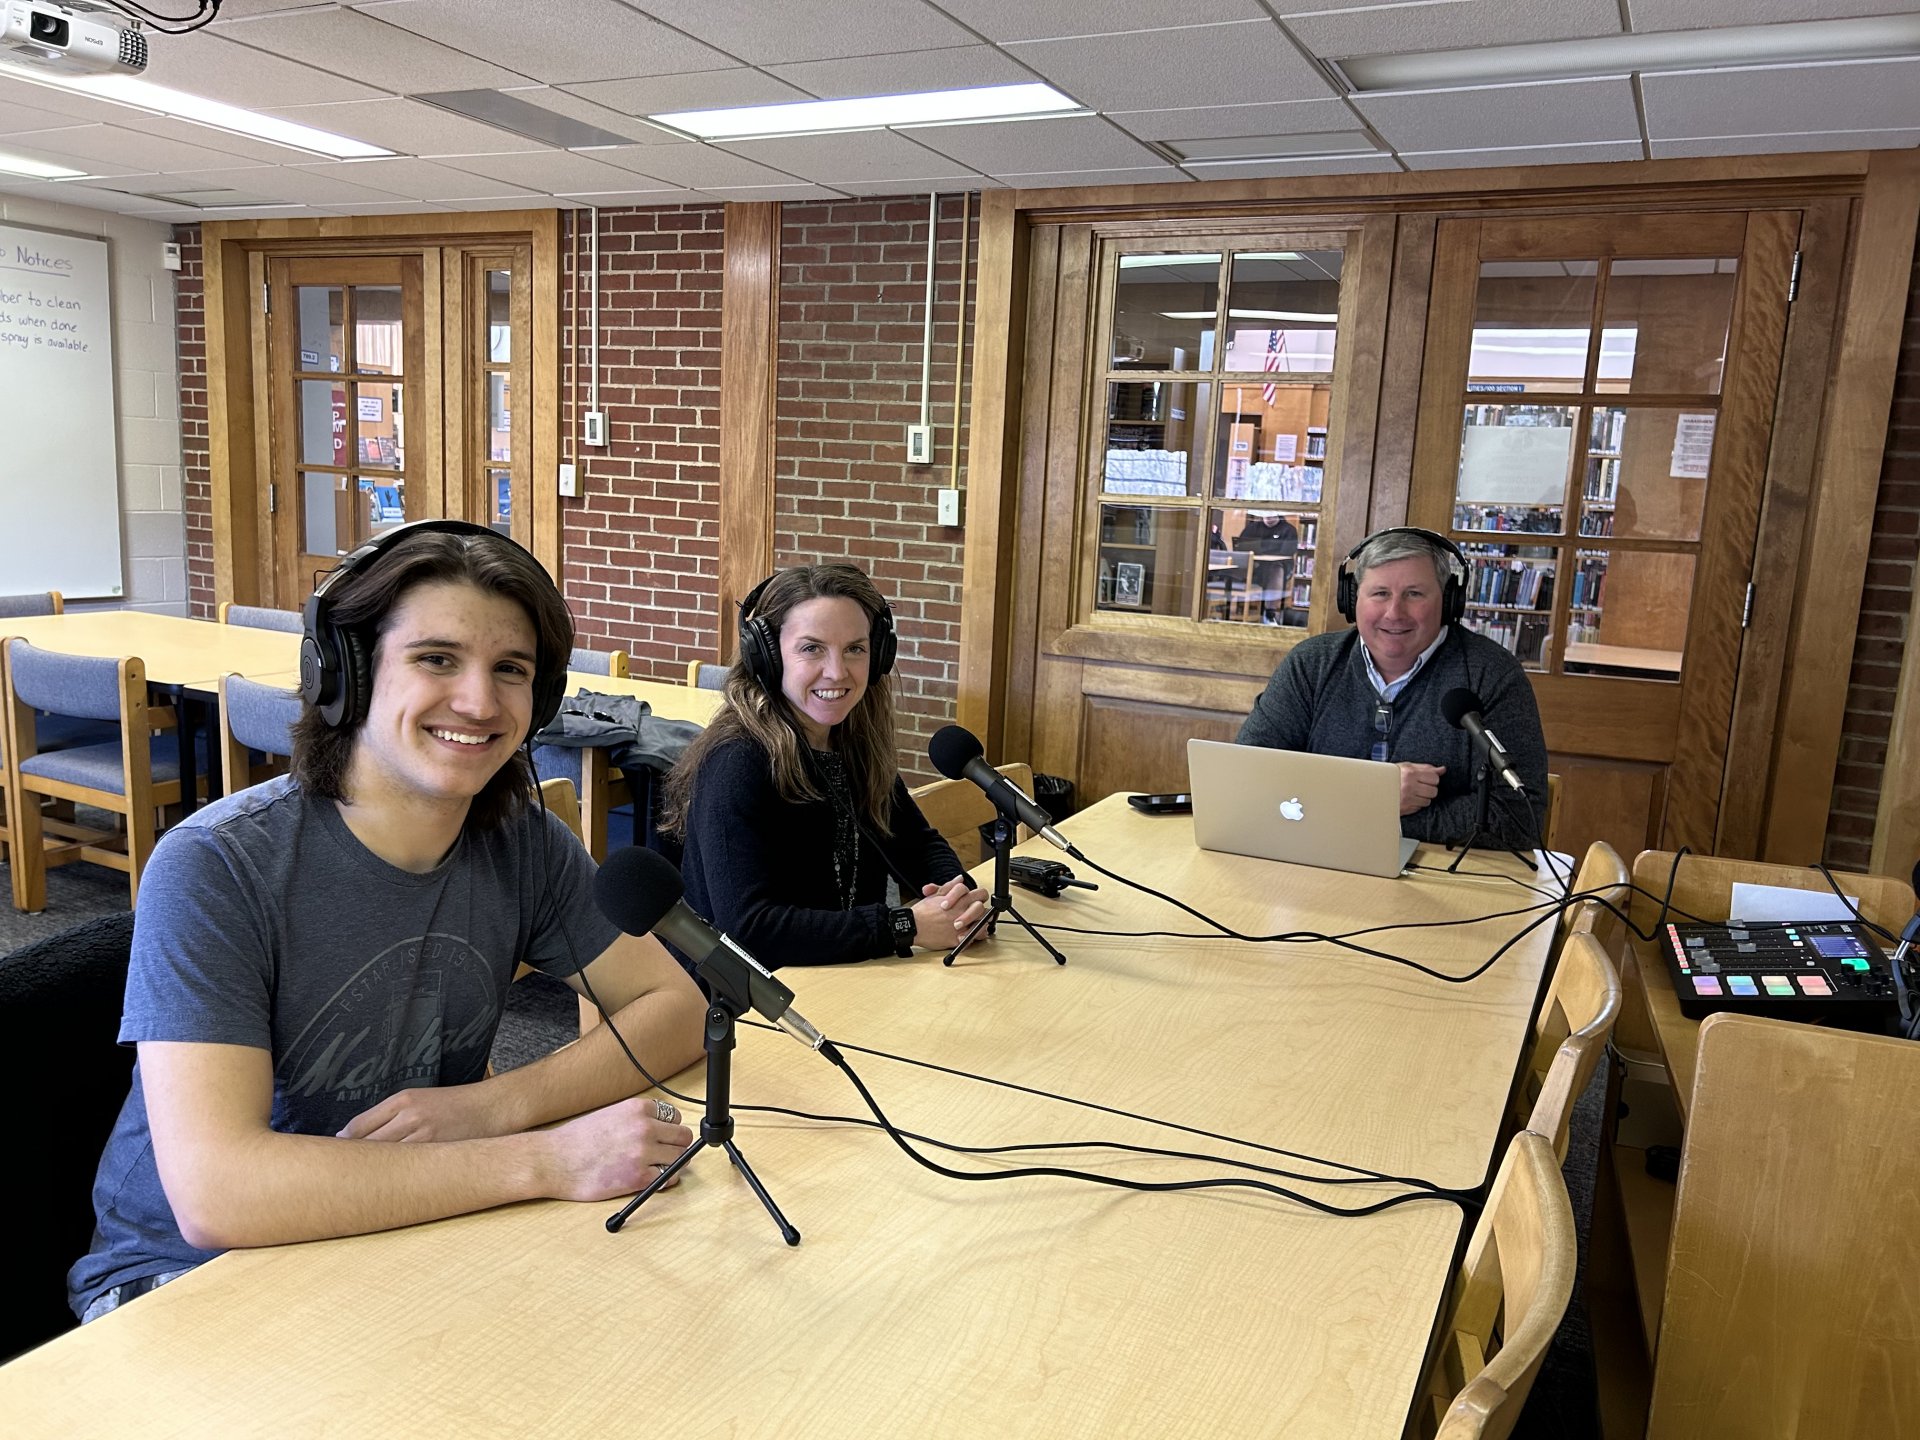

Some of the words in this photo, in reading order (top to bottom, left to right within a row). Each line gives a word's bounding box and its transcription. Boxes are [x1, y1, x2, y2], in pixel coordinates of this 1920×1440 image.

[84, 36, 104, 45] EPSON
[17, 246, 73, 270] Notices
[28, 291, 41, 306] to
[47, 296, 81, 310] clean
[18, 315, 46, 328] when
[51, 320, 78, 333] done
[1, 332, 29, 349] spray
[33, 336, 42, 345] is
